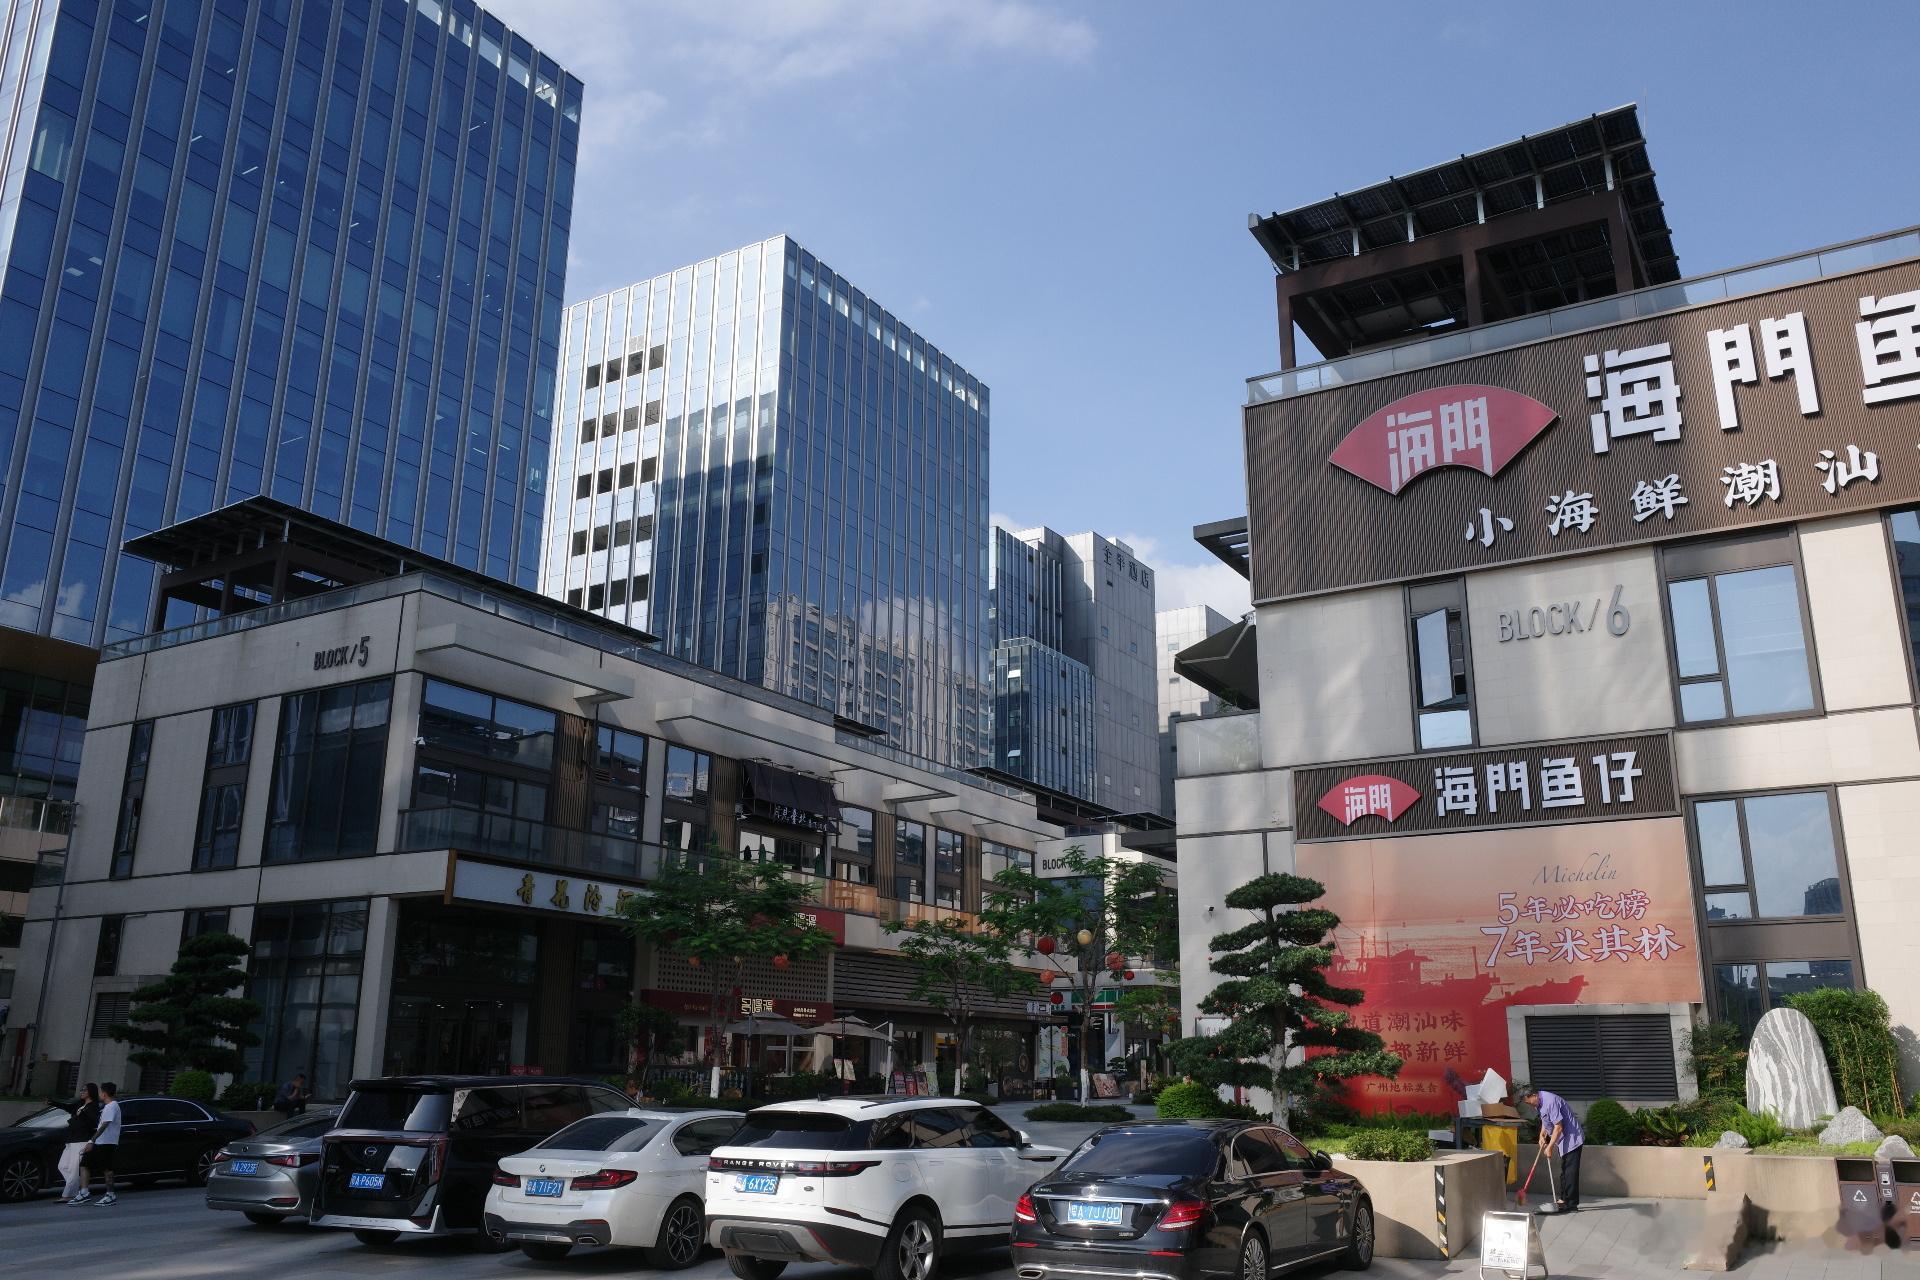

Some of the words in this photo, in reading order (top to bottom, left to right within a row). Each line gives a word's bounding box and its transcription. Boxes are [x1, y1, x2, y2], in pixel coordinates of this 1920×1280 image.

[1465, 444, 1879, 548] 小海鲜潮汕
[1434, 751, 1643, 817] 海門鱼仔
[1532, 852, 1619, 886] Michelin
[1497, 889, 1651, 926] 5年必吃榜
[1480, 924, 1686, 967] 7年米其林
[1366, 1082, 1439, 1094] 广州地标美食
[723, 1159, 754, 1167] RANGE
[758, 1160, 795, 1168] ROVER
